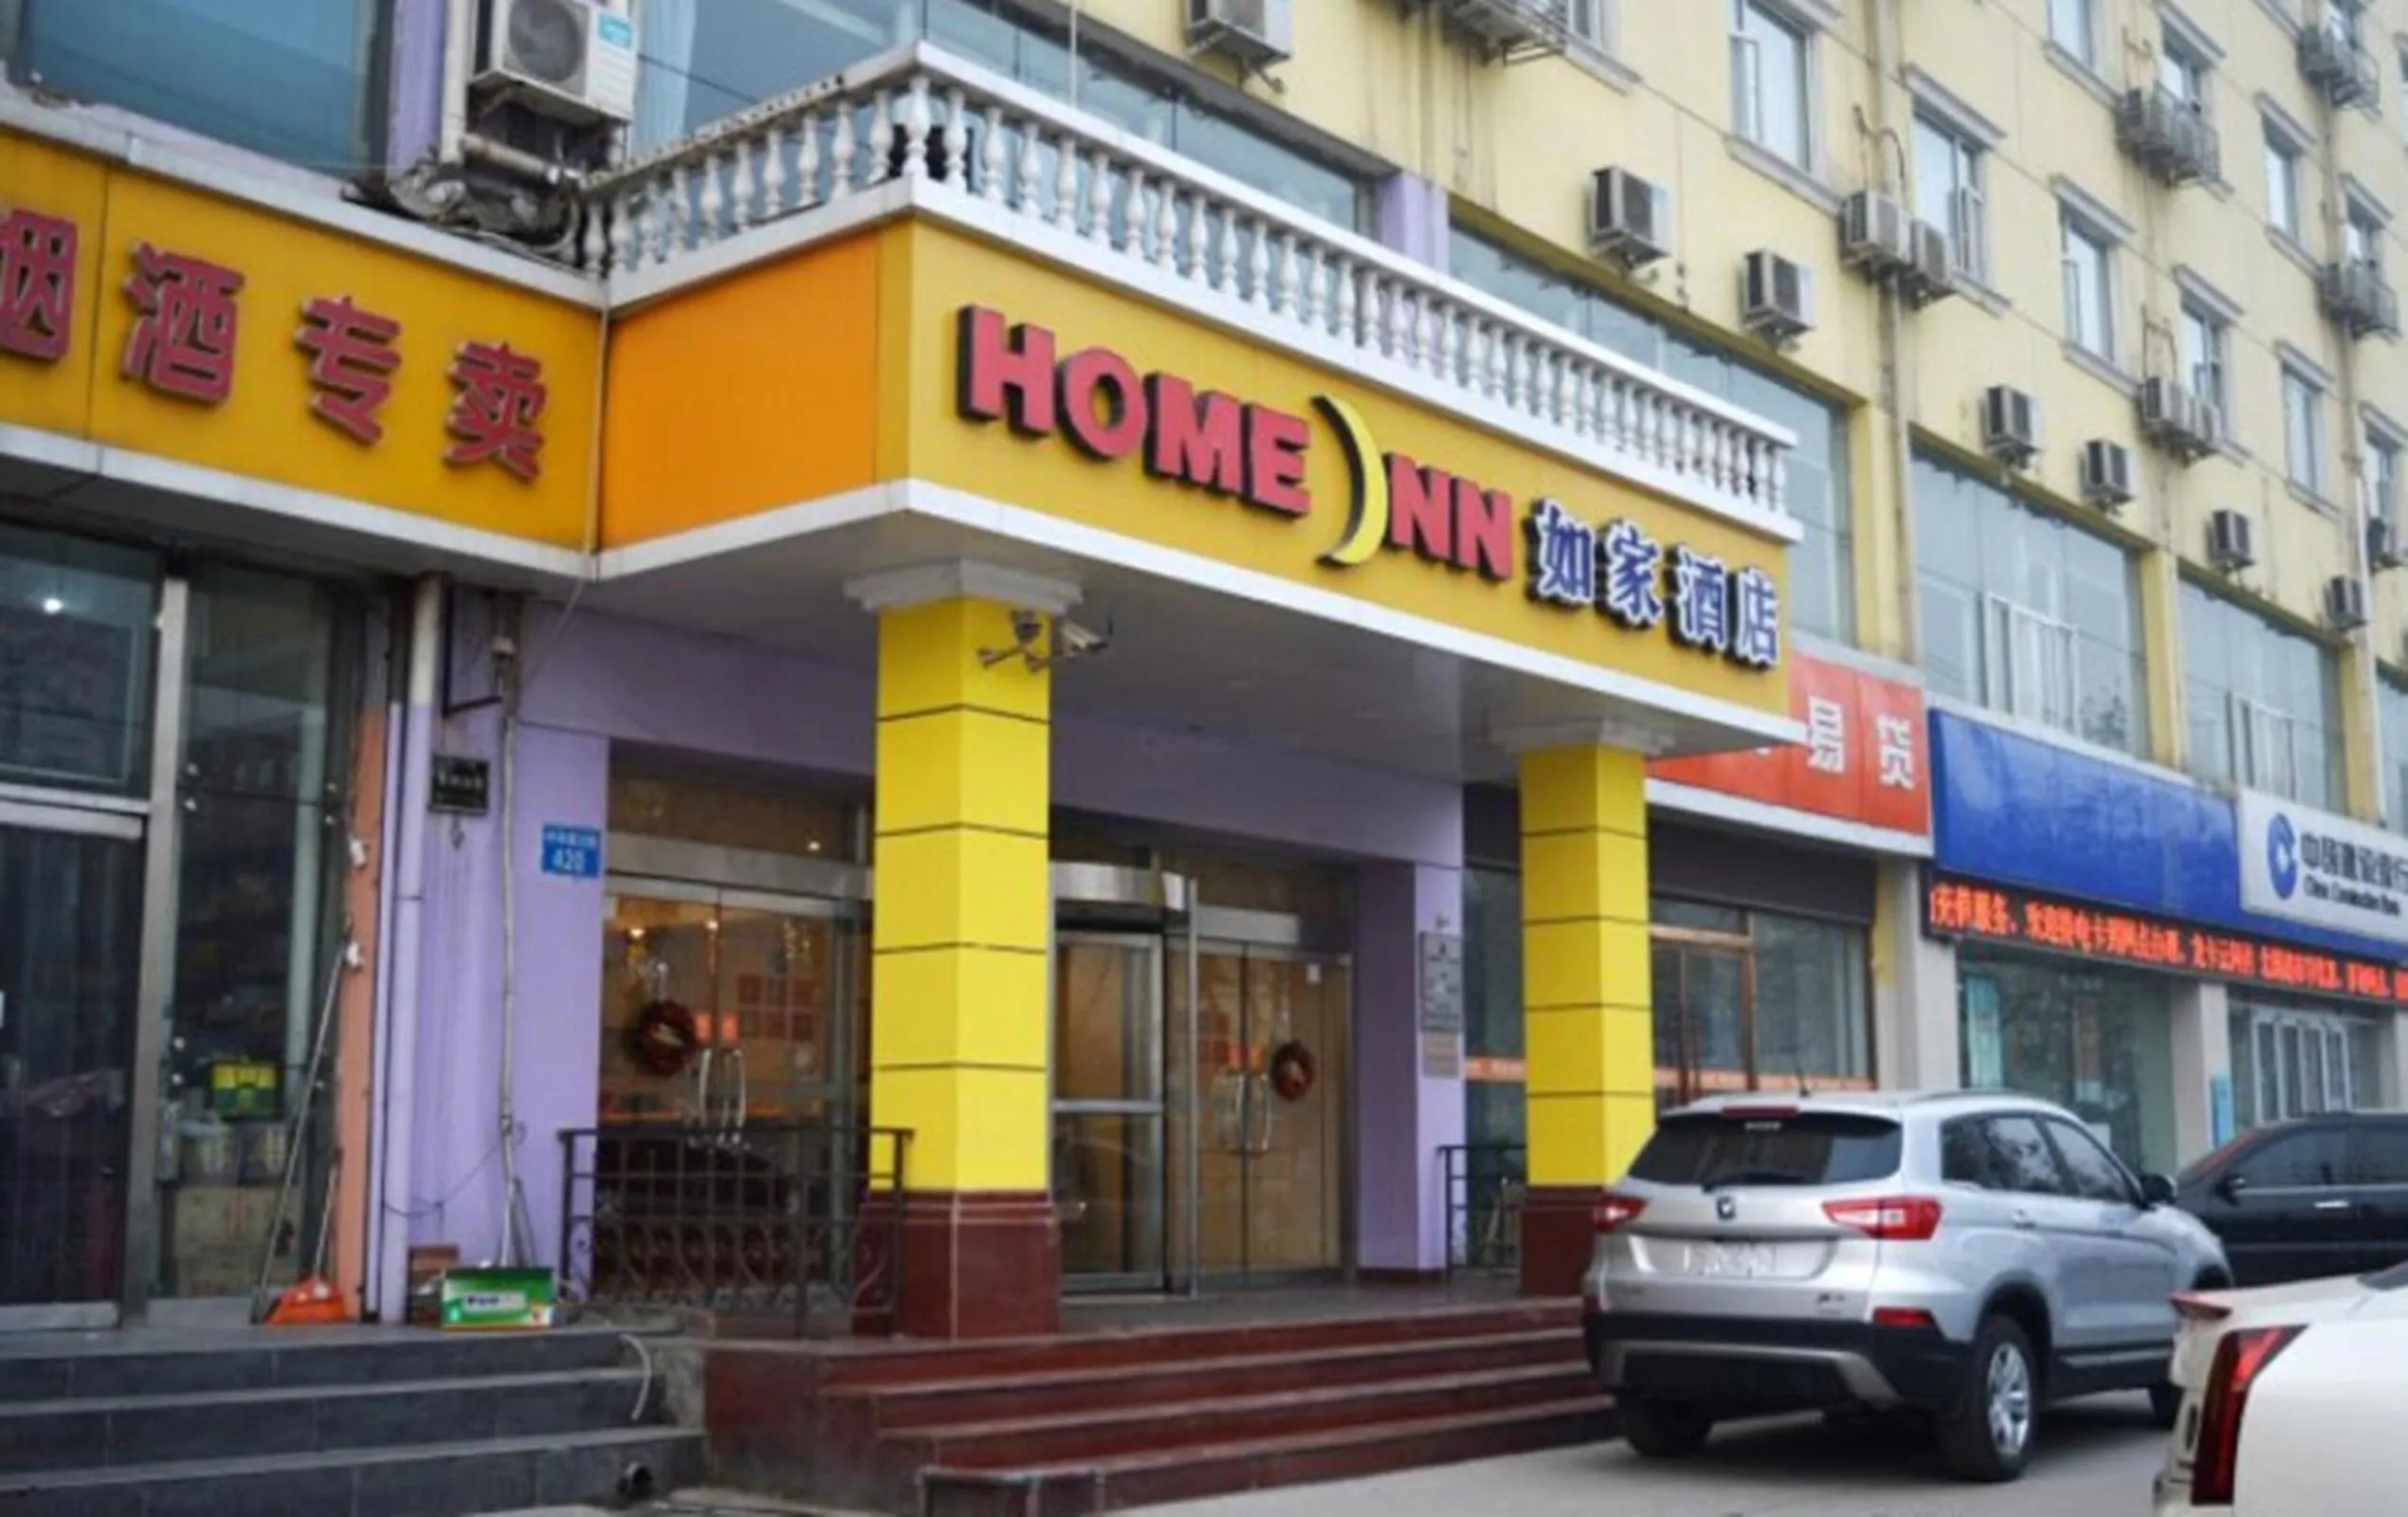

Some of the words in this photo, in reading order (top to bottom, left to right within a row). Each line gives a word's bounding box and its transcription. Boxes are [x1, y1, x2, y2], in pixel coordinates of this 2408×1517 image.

[0, 207, 548, 484] 烟酒专卖
[958, 304, 1310, 519] HOME
[1527, 496, 1780, 669] 如家酒店
